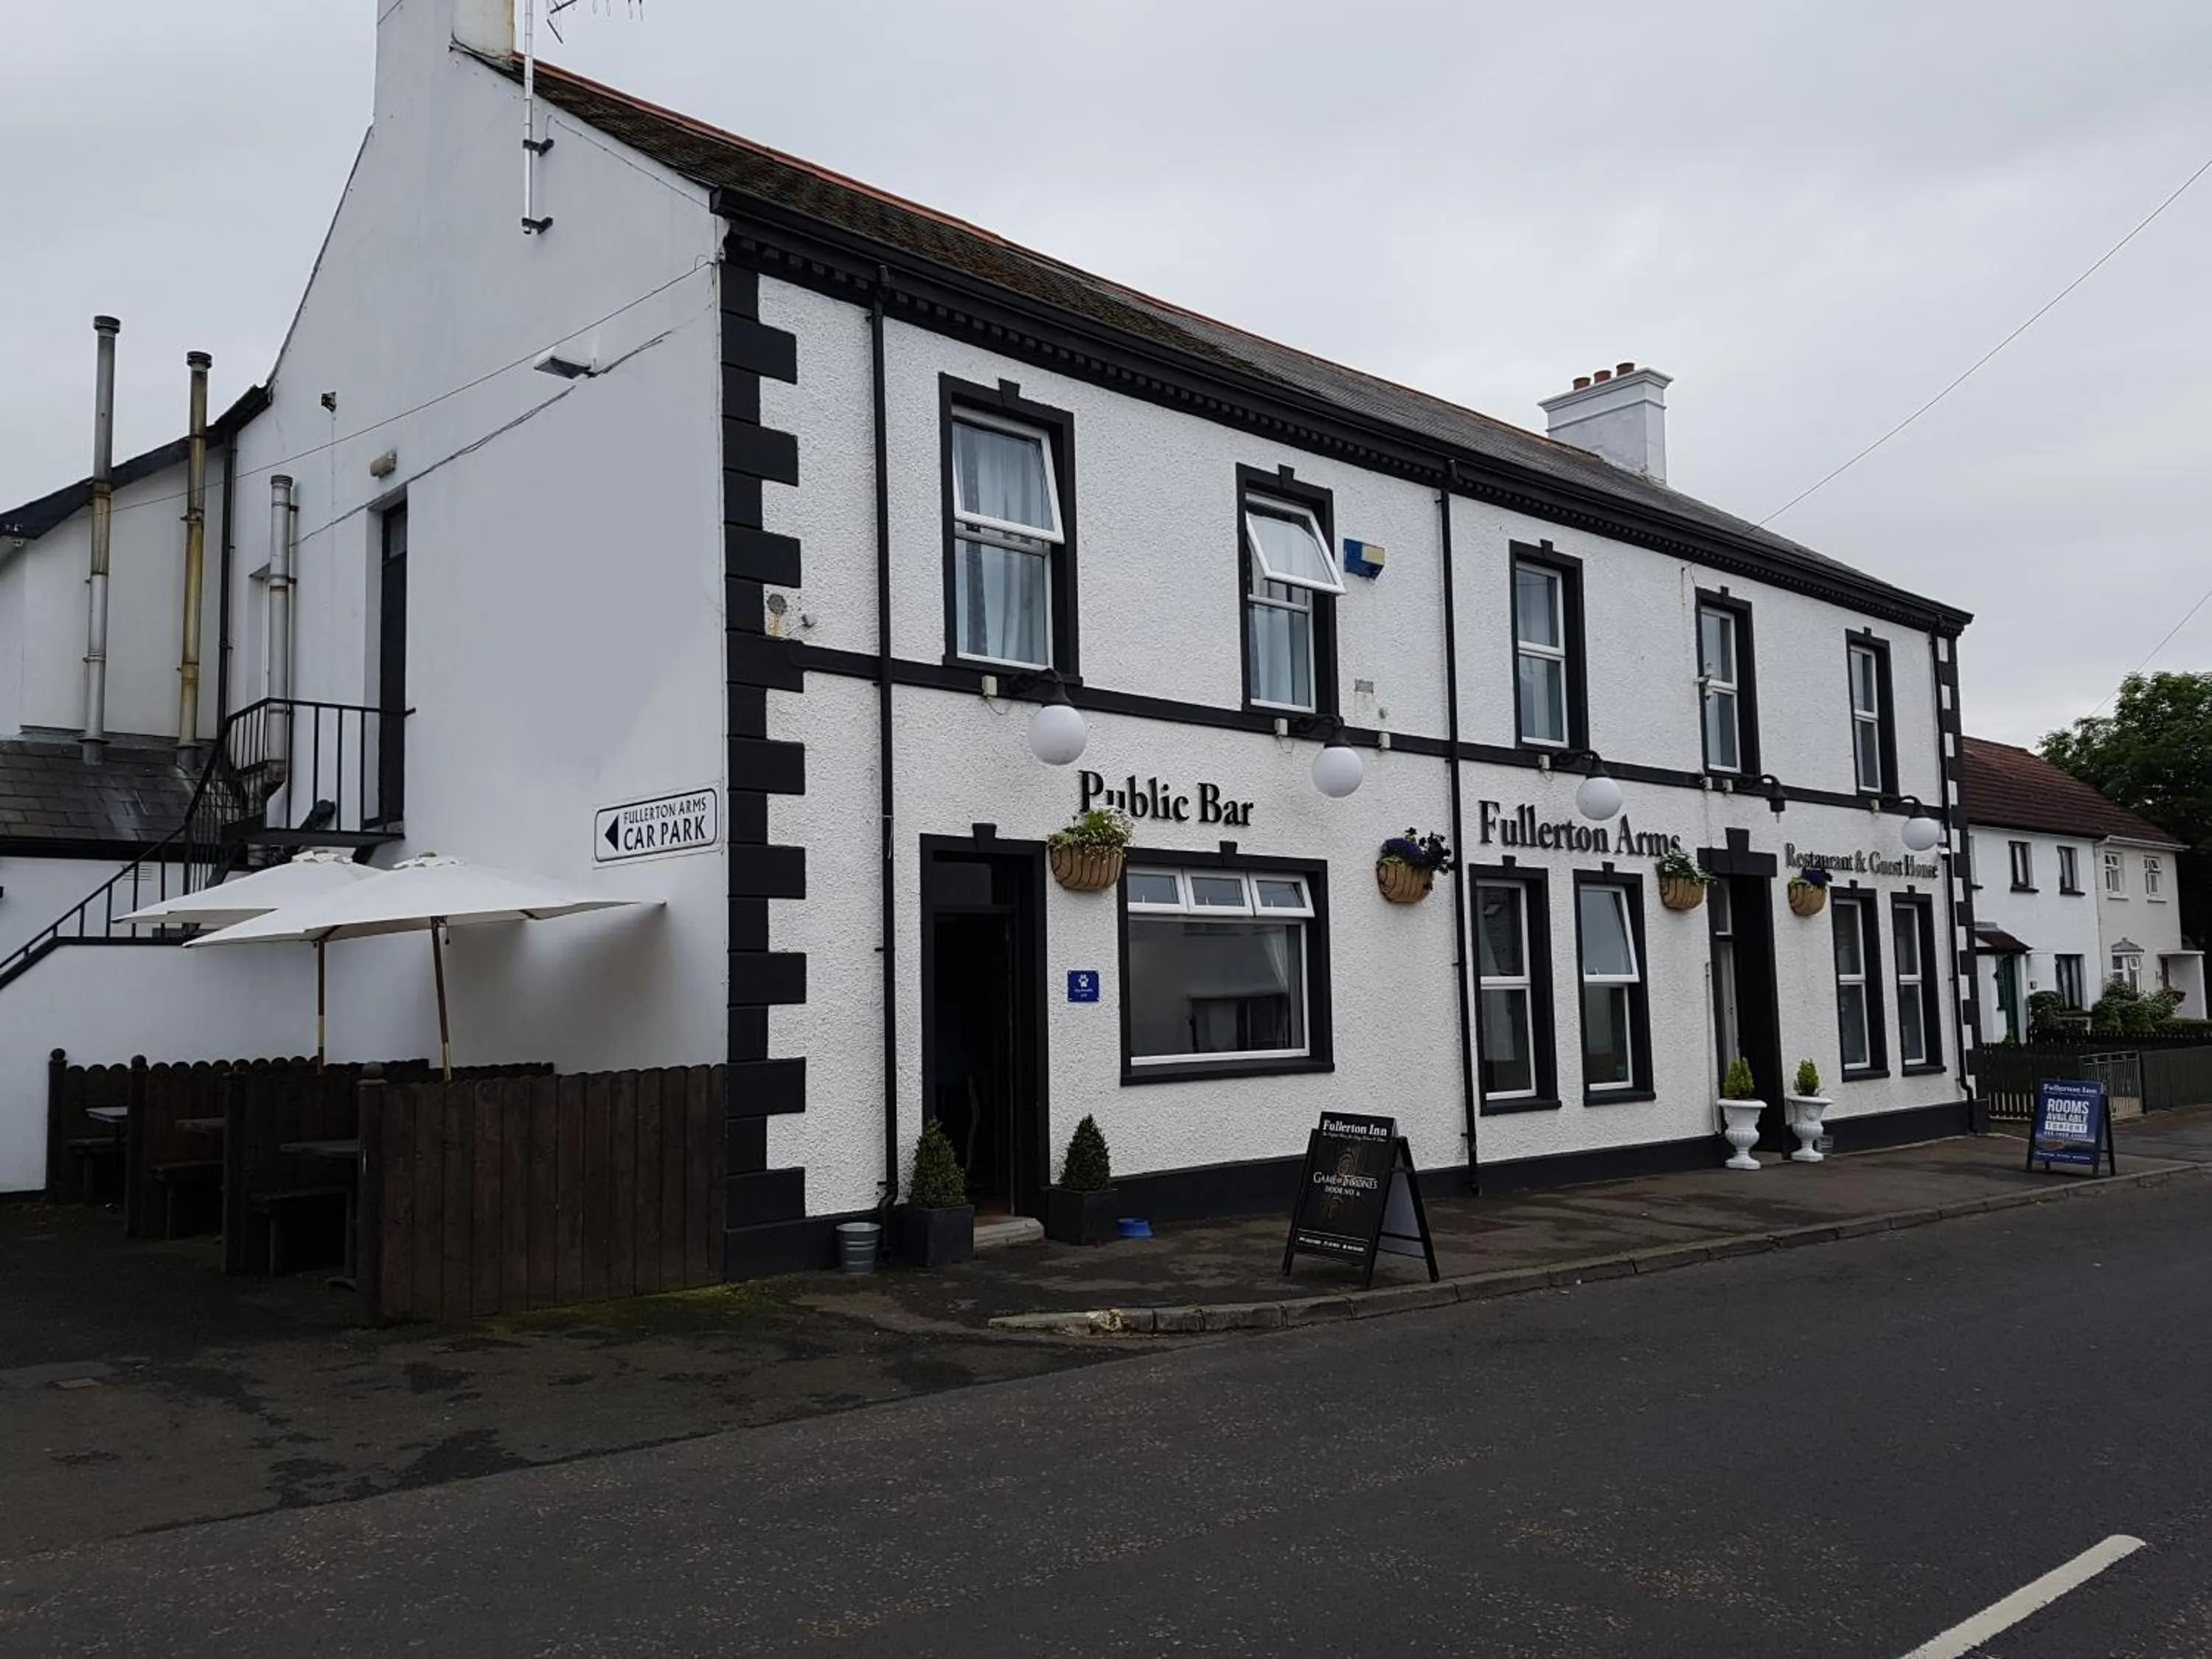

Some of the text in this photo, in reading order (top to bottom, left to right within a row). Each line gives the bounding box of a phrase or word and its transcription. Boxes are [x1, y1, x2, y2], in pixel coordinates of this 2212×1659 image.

[624, 797, 706, 824] FULLERTON ARMS
[1078, 770, 1253, 826] Public Bar
[624, 815, 706, 851] CAR PARK
[1478, 800, 1680, 856] Fullerton Arms
[1784, 843, 1938, 878] Restaurant & Guest House
[2047, 1112, 2088, 1124] AVAILABLE
[2048, 1099, 2090, 1114] ROOMS
[1323, 1120, 1387, 1136] Fullerton Inn
